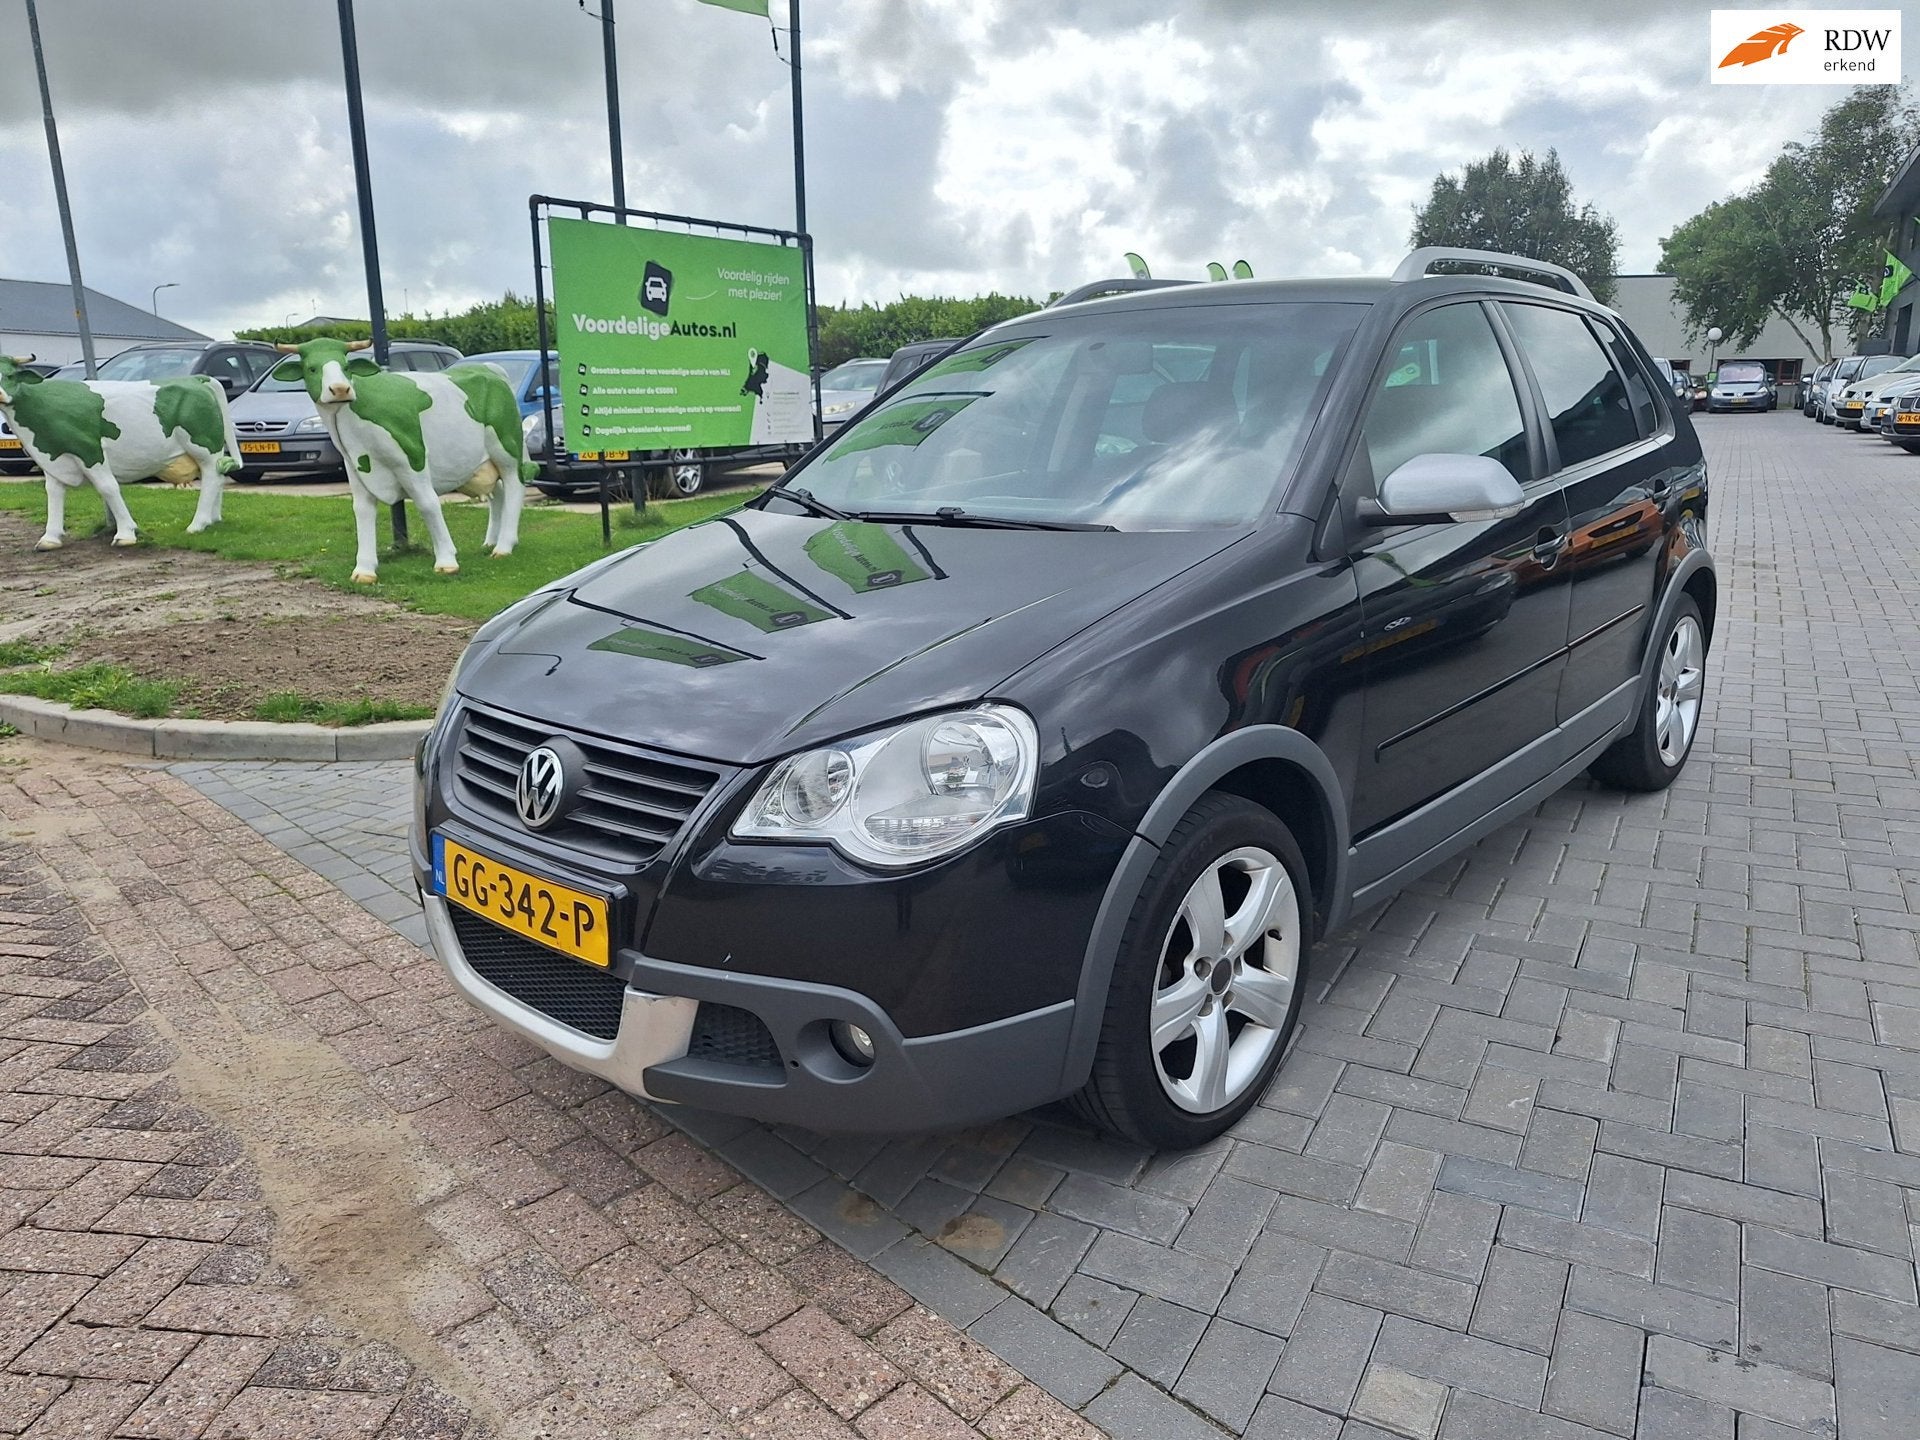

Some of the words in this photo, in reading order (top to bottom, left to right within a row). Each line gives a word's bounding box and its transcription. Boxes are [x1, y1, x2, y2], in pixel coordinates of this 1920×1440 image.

[717, 267, 762, 285] Voordelig
[763, 272, 790, 287] rijden
[728, 287, 747, 299] met
[749, 288, 782, 302] plezier!
[572, 313, 737, 340] VoordeligeAutos.nl
[658, 367, 689, 377] voordelige
[592, 387, 606, 395] Alle
[607, 387, 627, 395] auto's
[627, 387, 646, 395] onder
[646, 387, 655, 395] de
[594, 406, 613, 416] Altijd
[613, 406, 643, 415] minimaal
[655, 406, 687, 415] voordelige
[595, 425, 626, 436] Dagelijks
[435, 873, 446, 885] NL
[453, 853, 595, 947] GG-342-P
